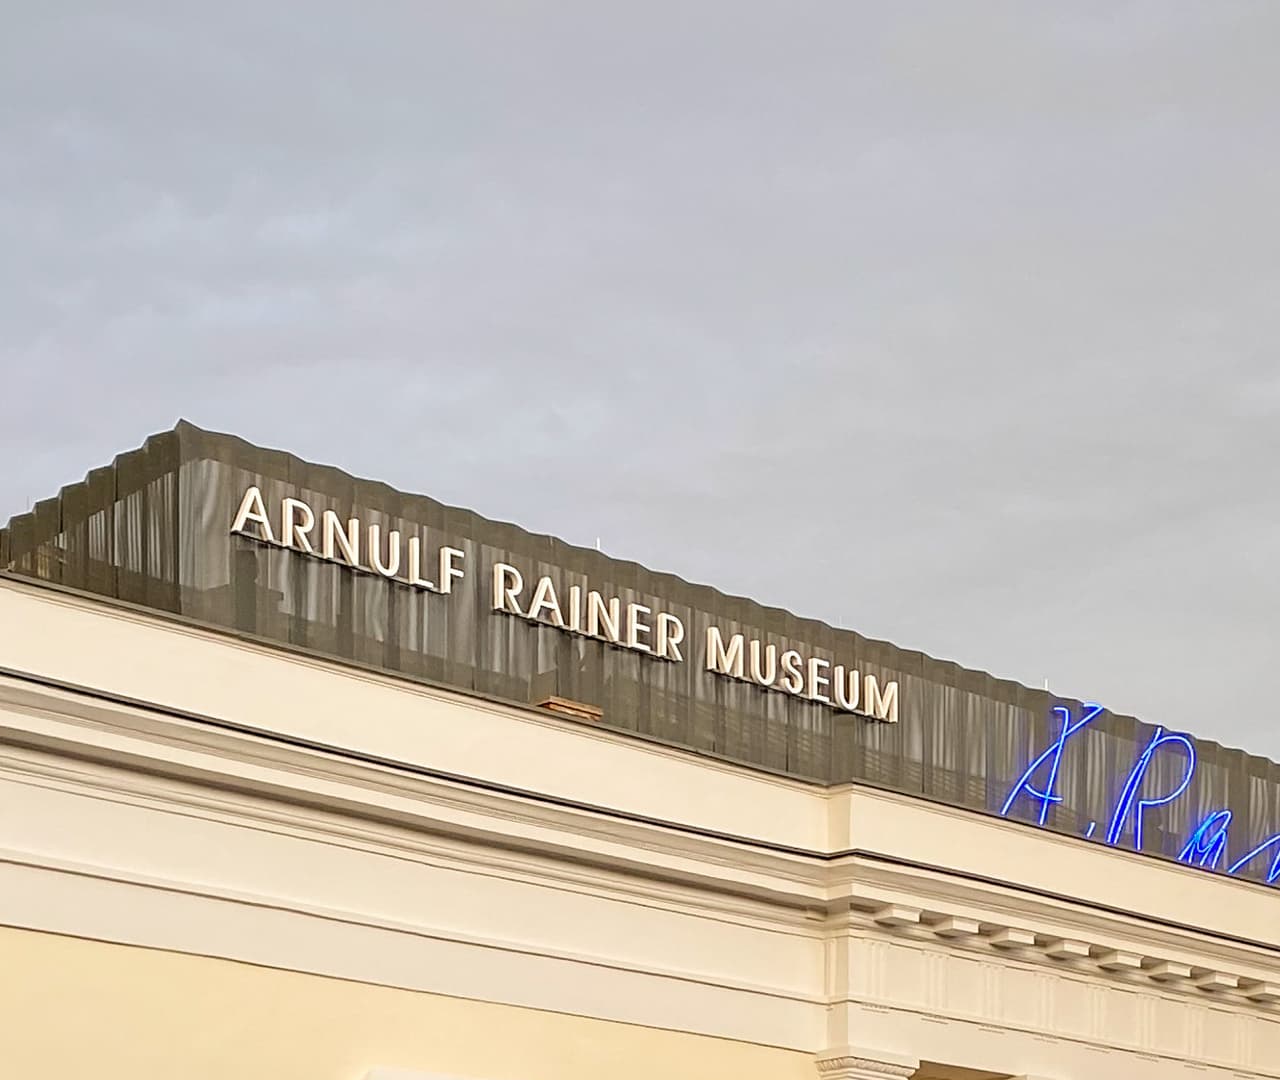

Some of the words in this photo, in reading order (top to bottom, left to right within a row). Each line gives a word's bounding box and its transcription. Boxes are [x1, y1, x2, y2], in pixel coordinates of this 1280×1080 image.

[230, 486, 465, 594] ARNULF
[493, 563, 685, 662] RAINER
[706, 626, 899, 724] MUSEUM
